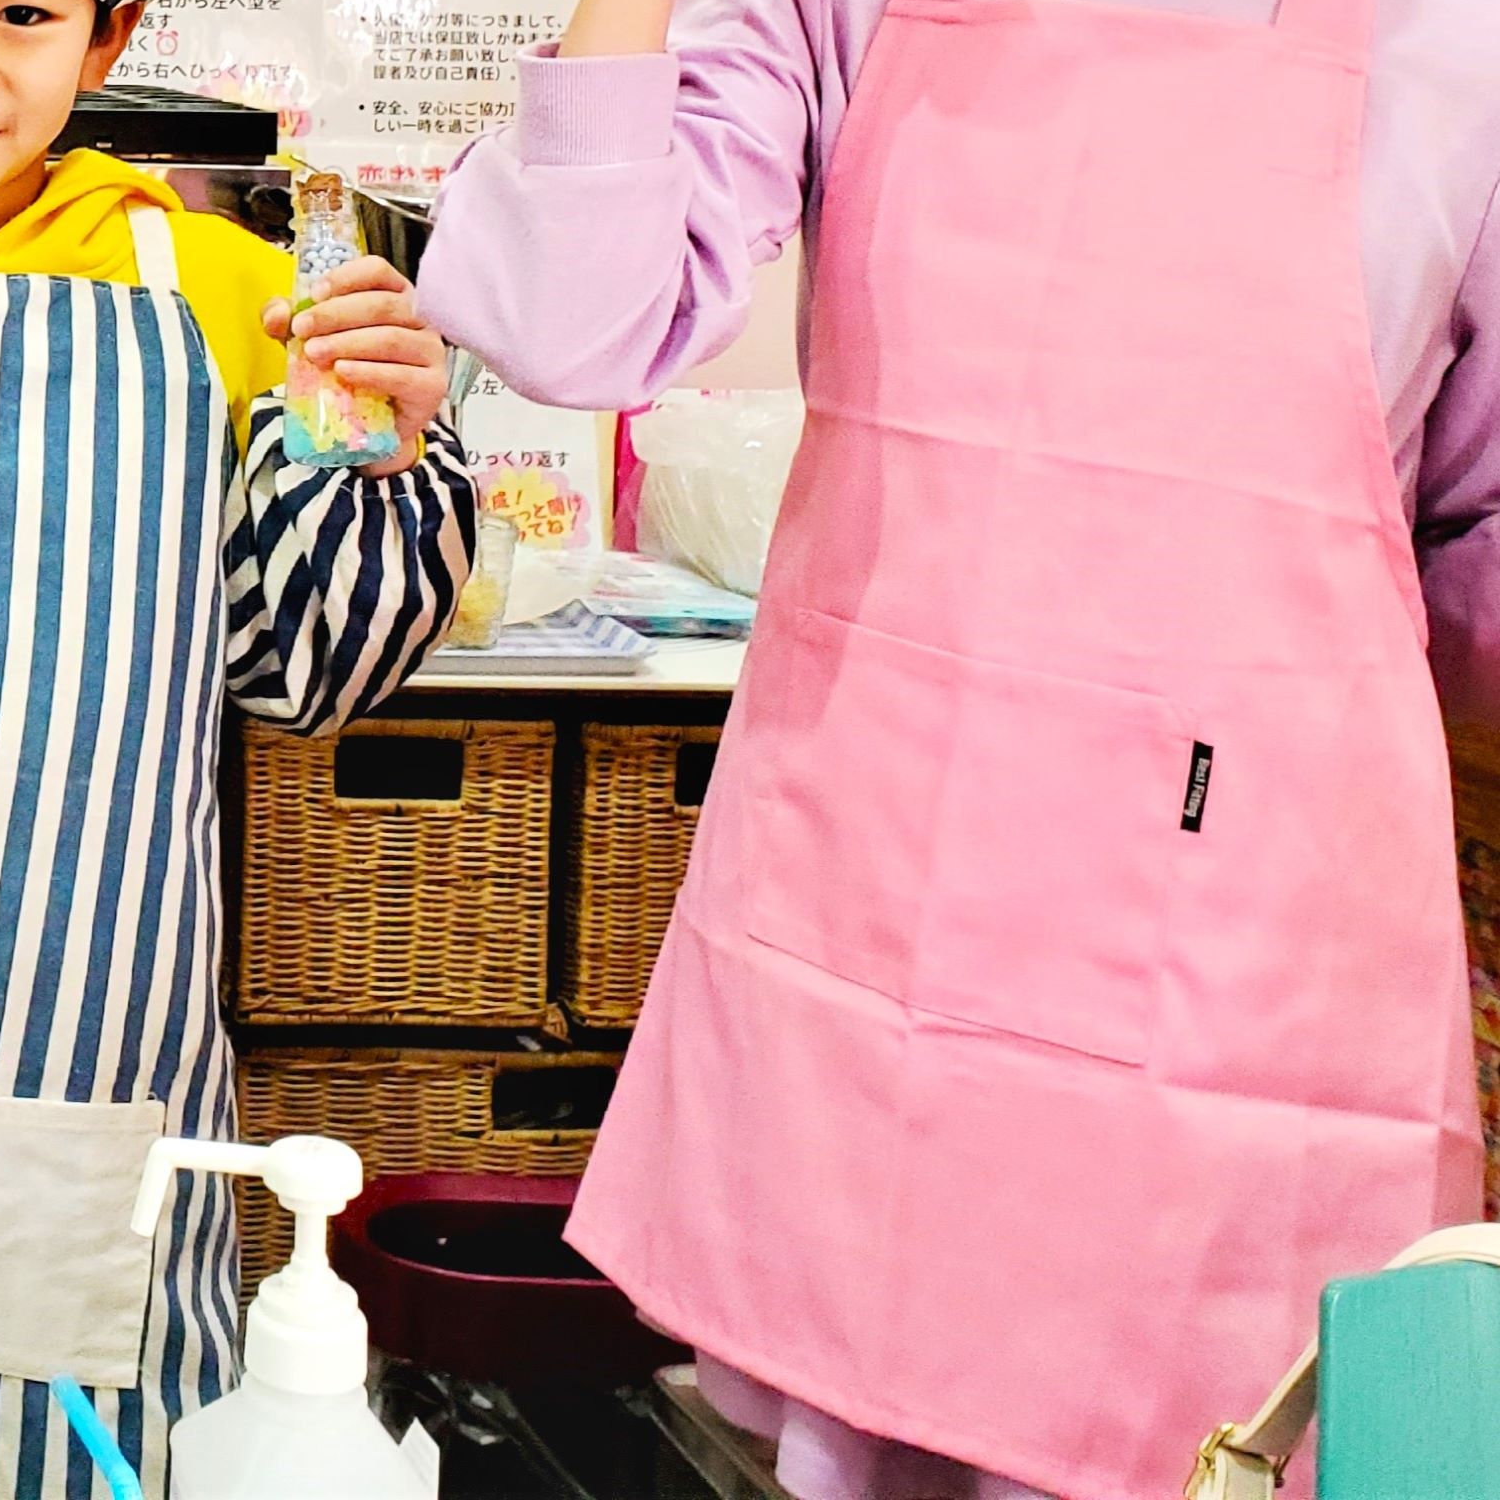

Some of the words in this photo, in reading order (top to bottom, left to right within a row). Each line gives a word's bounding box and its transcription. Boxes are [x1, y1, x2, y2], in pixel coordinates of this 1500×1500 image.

[467, 450, 570, 467] ひっくり返す
